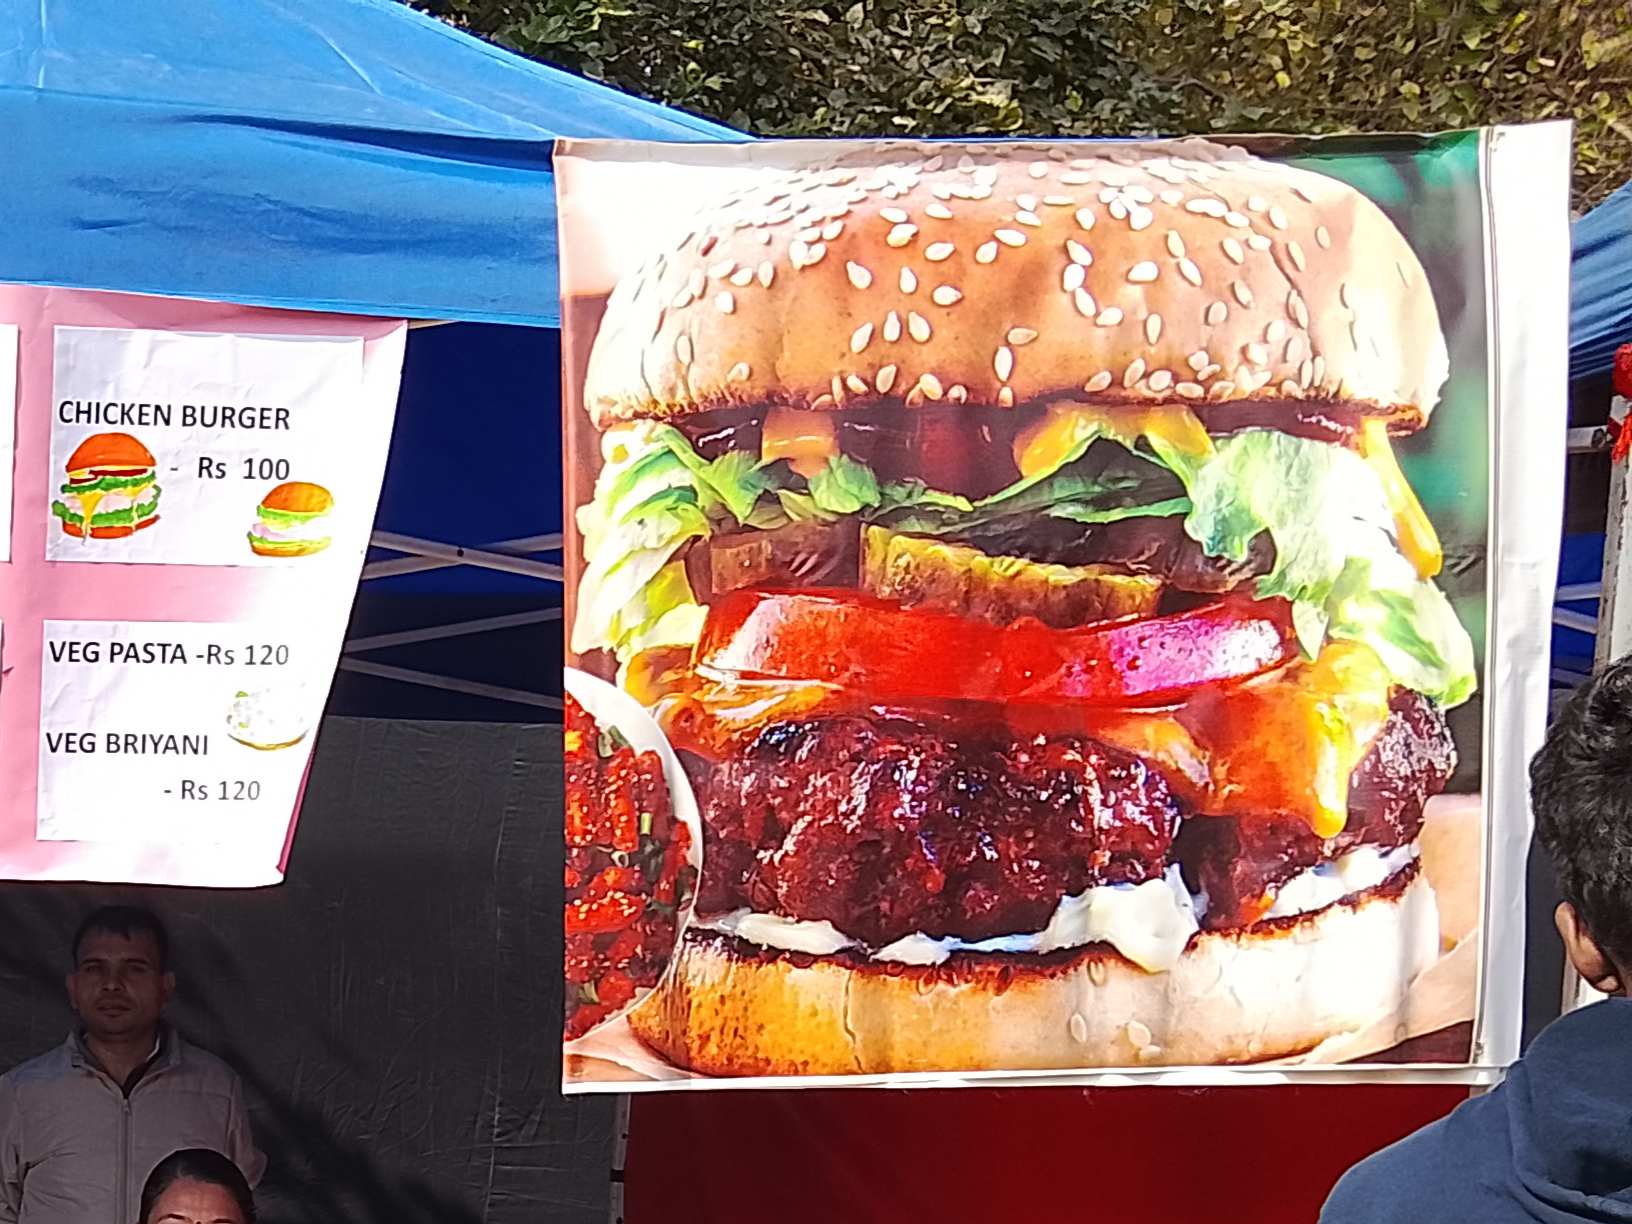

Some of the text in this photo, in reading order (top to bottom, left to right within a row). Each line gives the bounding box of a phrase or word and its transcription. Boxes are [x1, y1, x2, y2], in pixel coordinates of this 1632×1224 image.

[58, 400, 290, 430] CHICKEN BURGER
[198, 456, 227, 479] Rs
[243, 458, 290, 480] 100
[48, 641, 289, 666] VEG PASTA -Rs 120
[46, 732, 208, 755] VEG BRIYANI
[181, 779, 208, 801] Rs
[218, 781, 261, 801] 120
